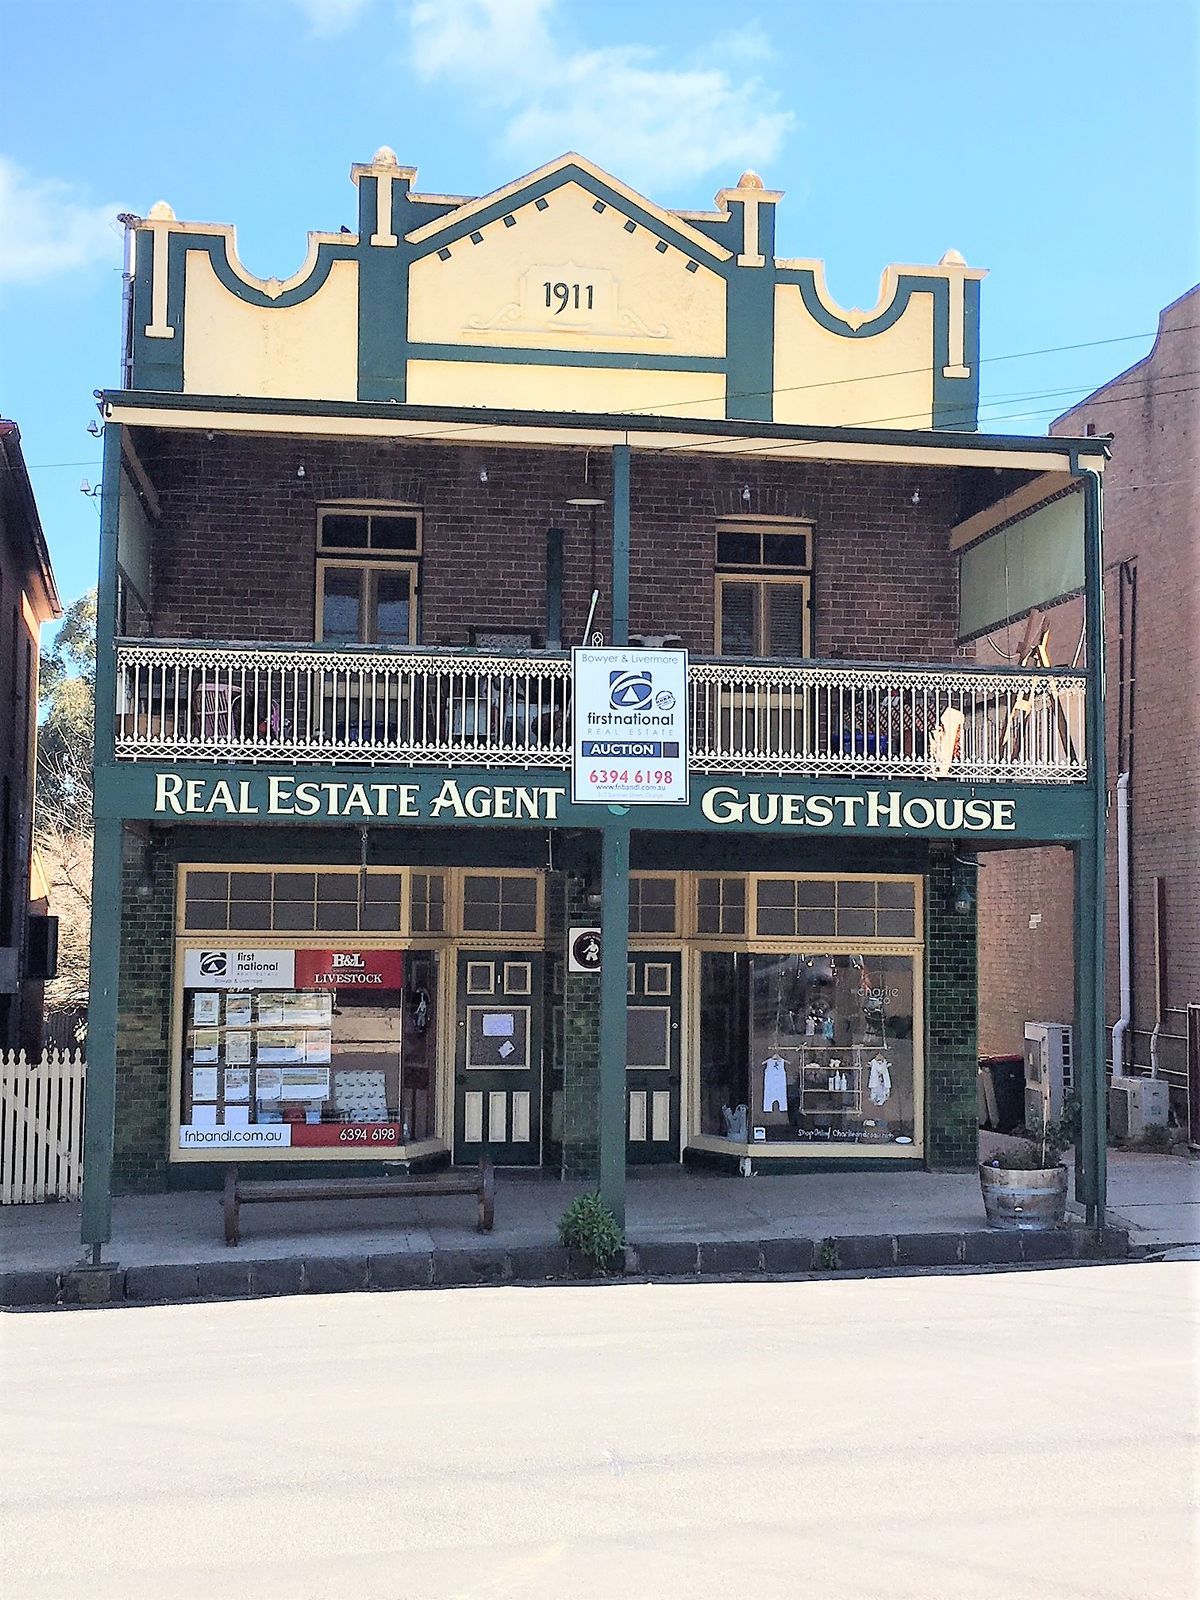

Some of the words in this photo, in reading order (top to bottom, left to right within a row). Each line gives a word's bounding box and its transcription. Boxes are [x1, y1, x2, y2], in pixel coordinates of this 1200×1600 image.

[543, 282, 593, 315] 1911
[582, 653, 618, 665] Bowyer
[621, 654, 628, 662] &
[631, 654, 679, 664] Livermore
[590, 743, 654, 755] AUCTION
[589, 770, 628, 783] 6394
[635, 770, 672, 784] 6198
[154, 773, 259, 815] REAL
[267, 776, 420, 817] ESTATE
[429, 779, 566, 819] AGENT
[237, 952, 255, 961] first
[332, 953, 365, 967] B&L
[237, 962, 278, 971] national
[314, 973, 382, 984] LIVESTOCK
[185, 1129, 282, 1142] fnbandl.com.au
[339, 1128, 367, 1141] 6394
[371, 1128, 395, 1141] 6198
